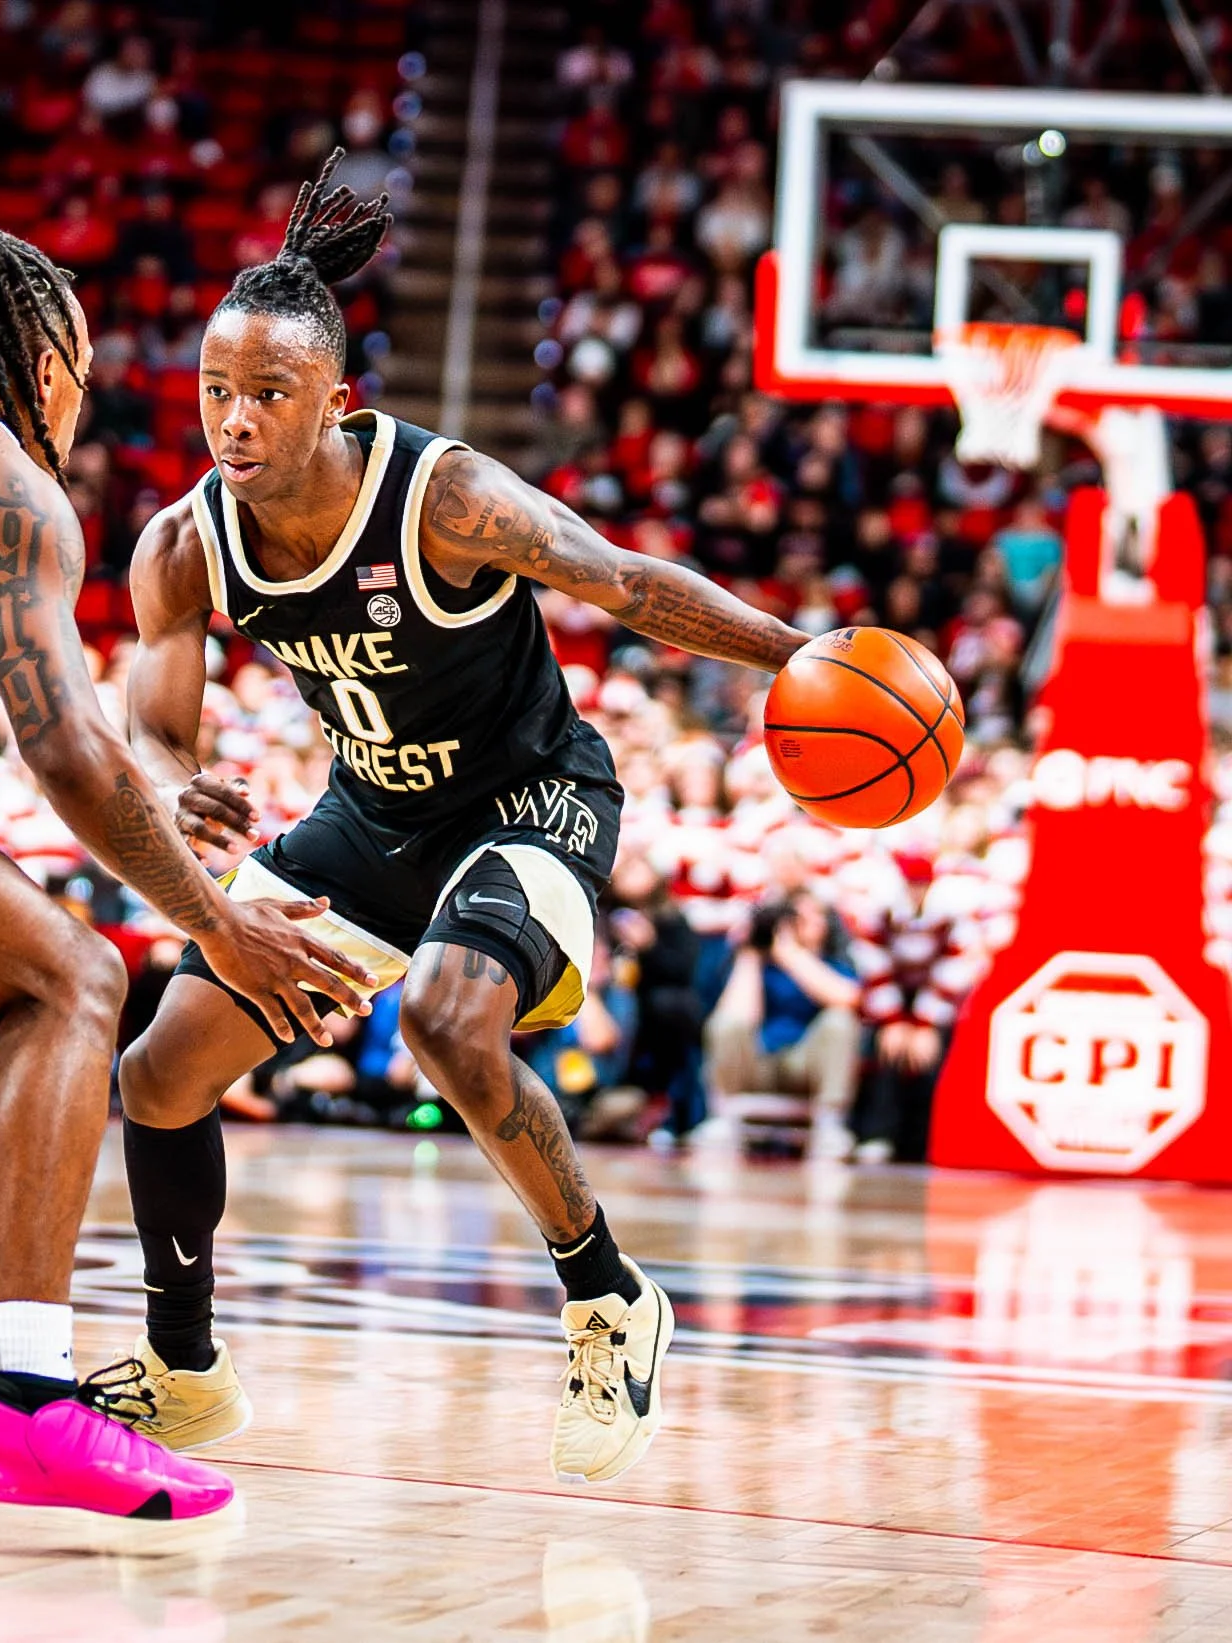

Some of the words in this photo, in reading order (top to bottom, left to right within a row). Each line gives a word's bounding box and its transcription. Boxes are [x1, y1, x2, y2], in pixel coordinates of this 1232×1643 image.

[374, 605, 396, 615] ACC
[260, 631, 409, 680] WAKE
[330, 678, 395, 745] 0
[1020, 1033, 1175, 1090] CPI
